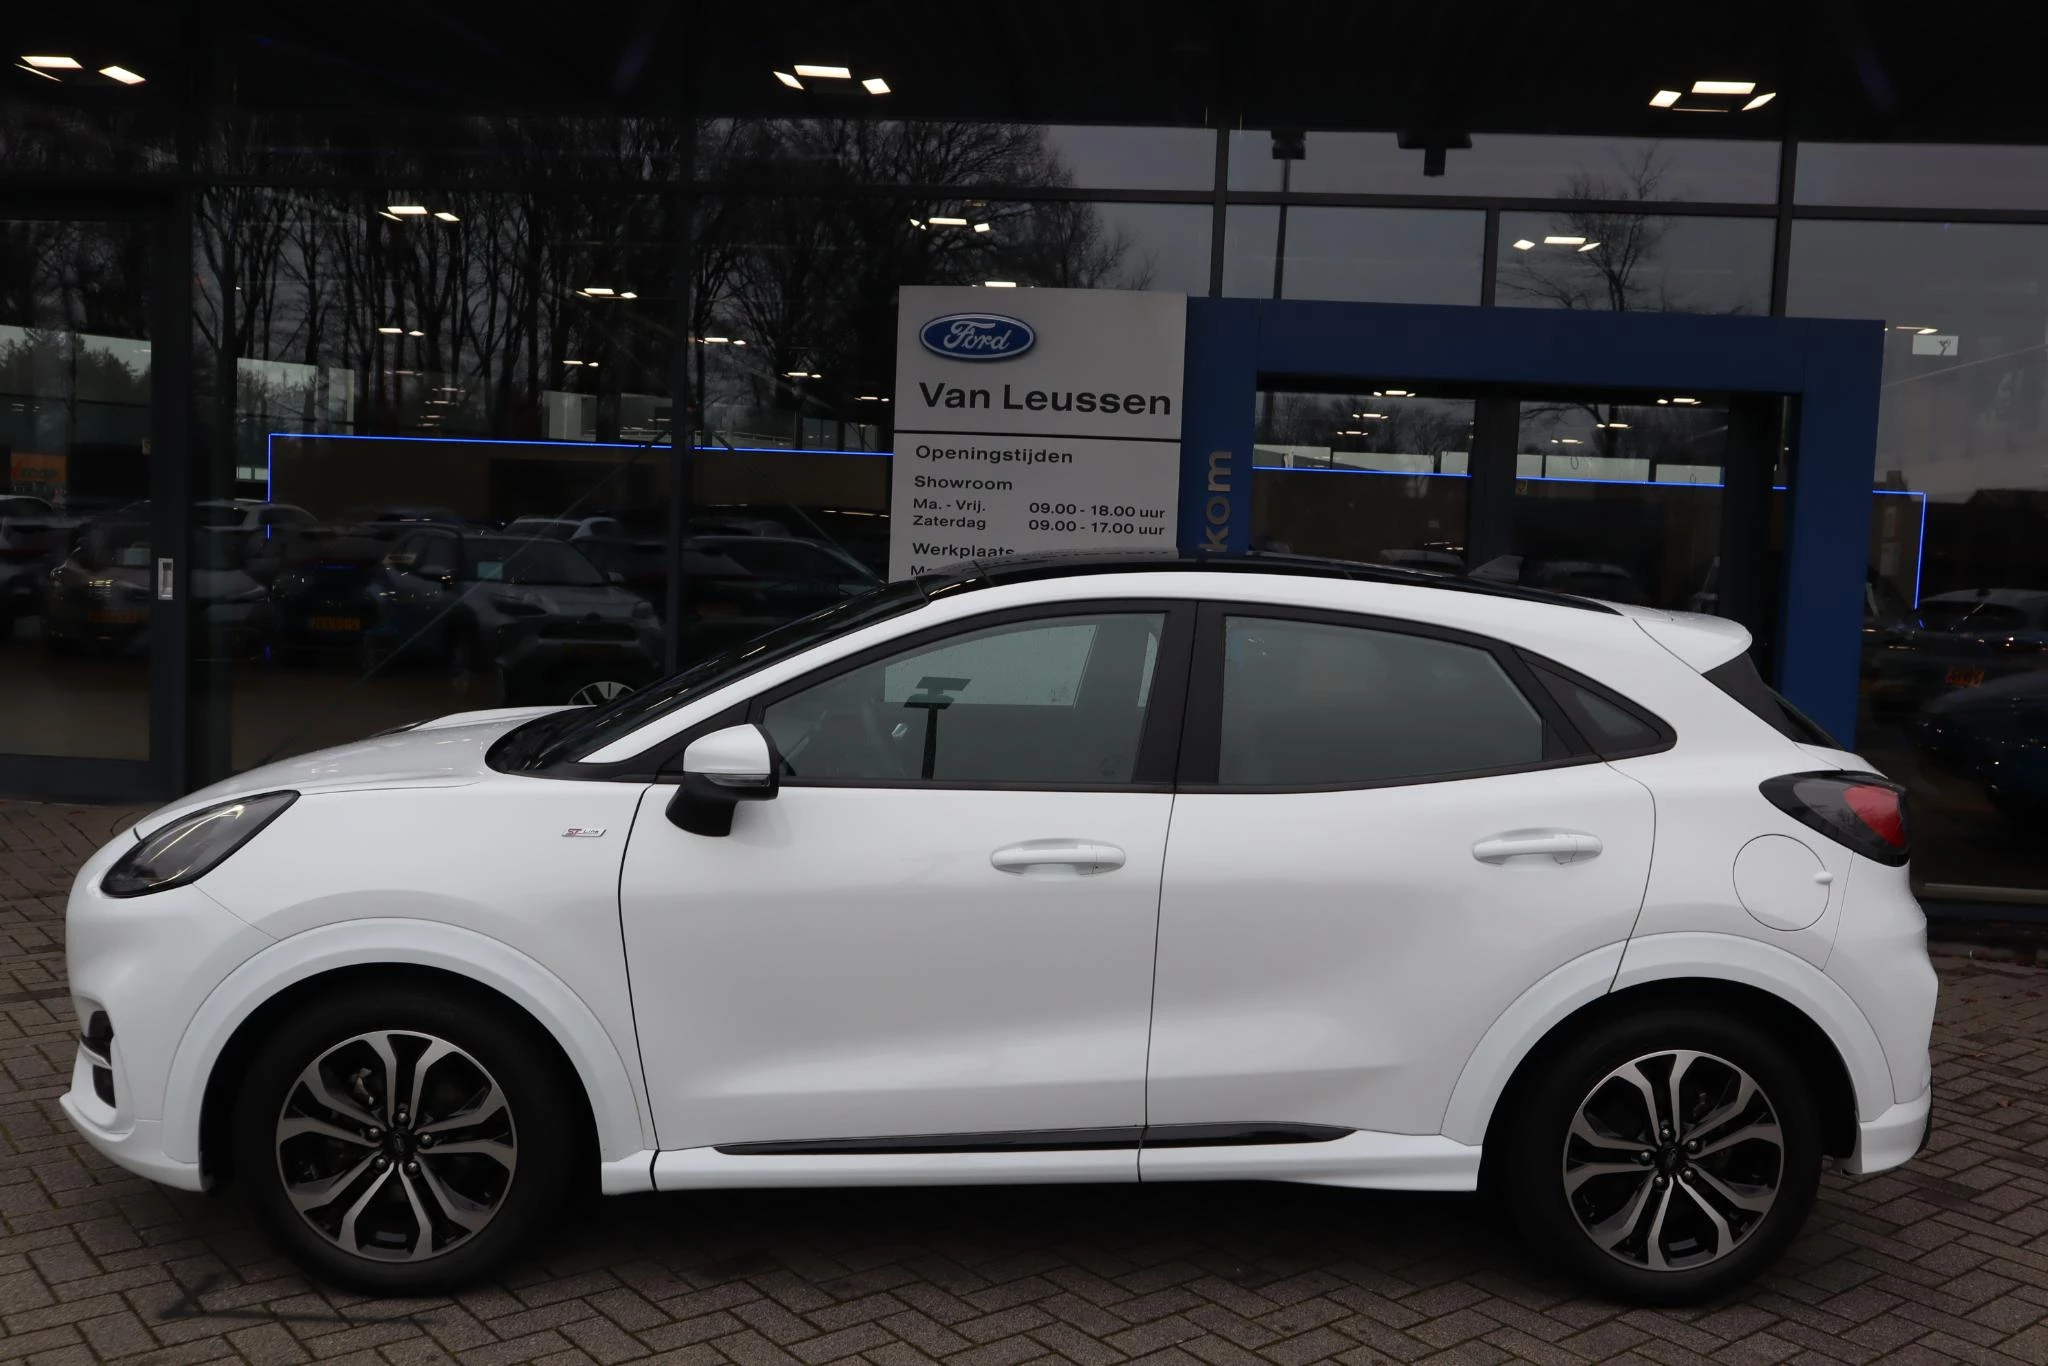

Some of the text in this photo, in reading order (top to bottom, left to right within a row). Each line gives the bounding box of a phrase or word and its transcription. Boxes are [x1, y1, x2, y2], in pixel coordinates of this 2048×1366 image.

[944, 320, 1012, 350] Ford
[919, 382, 1171, 415] Van Leussen
[915, 445, 1073, 464] Openingstijden
[914, 475, 1013, 491] Showroom
[913, 498, 942, 510] Ma.
[956, 499, 986, 513] Vrij.
[1029, 502, 1077, 515] 09.00
[1091, 504, 1136, 517] 18.00
[1140, 508, 1166, 519] uur
[913, 515, 986, 531] Zaterdag
[1028, 519, 1077, 532] 09.00
[1091, 522, 1135, 535] 17.00
[1139, 525, 1165, 536] uur
